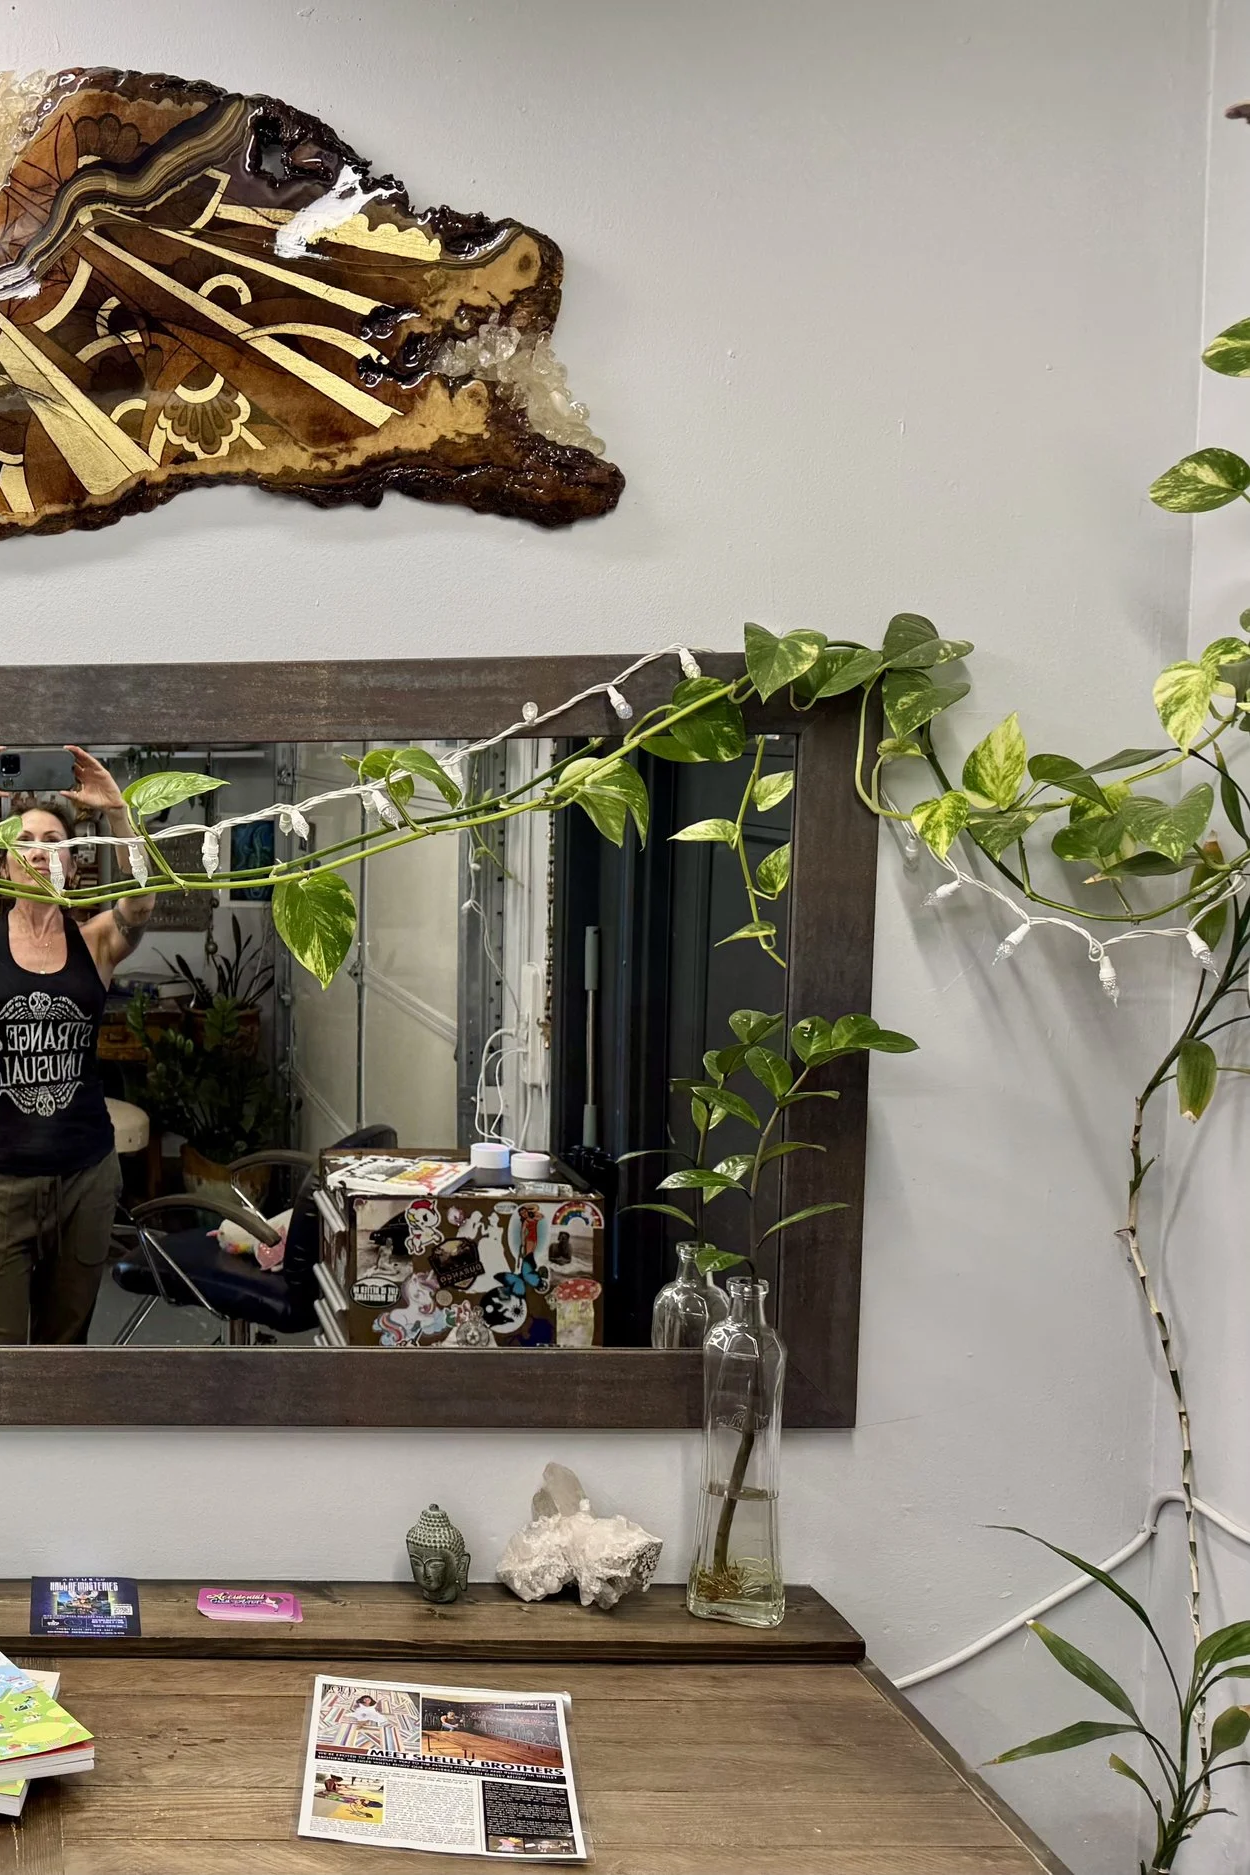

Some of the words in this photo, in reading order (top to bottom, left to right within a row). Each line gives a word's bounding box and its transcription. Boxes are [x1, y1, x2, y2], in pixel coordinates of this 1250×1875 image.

[370, 1749, 408, 1759] MEET
[413, 1754, 475, 1766] SHELLEY
[481, 1761, 564, 1776] BROTHERS
